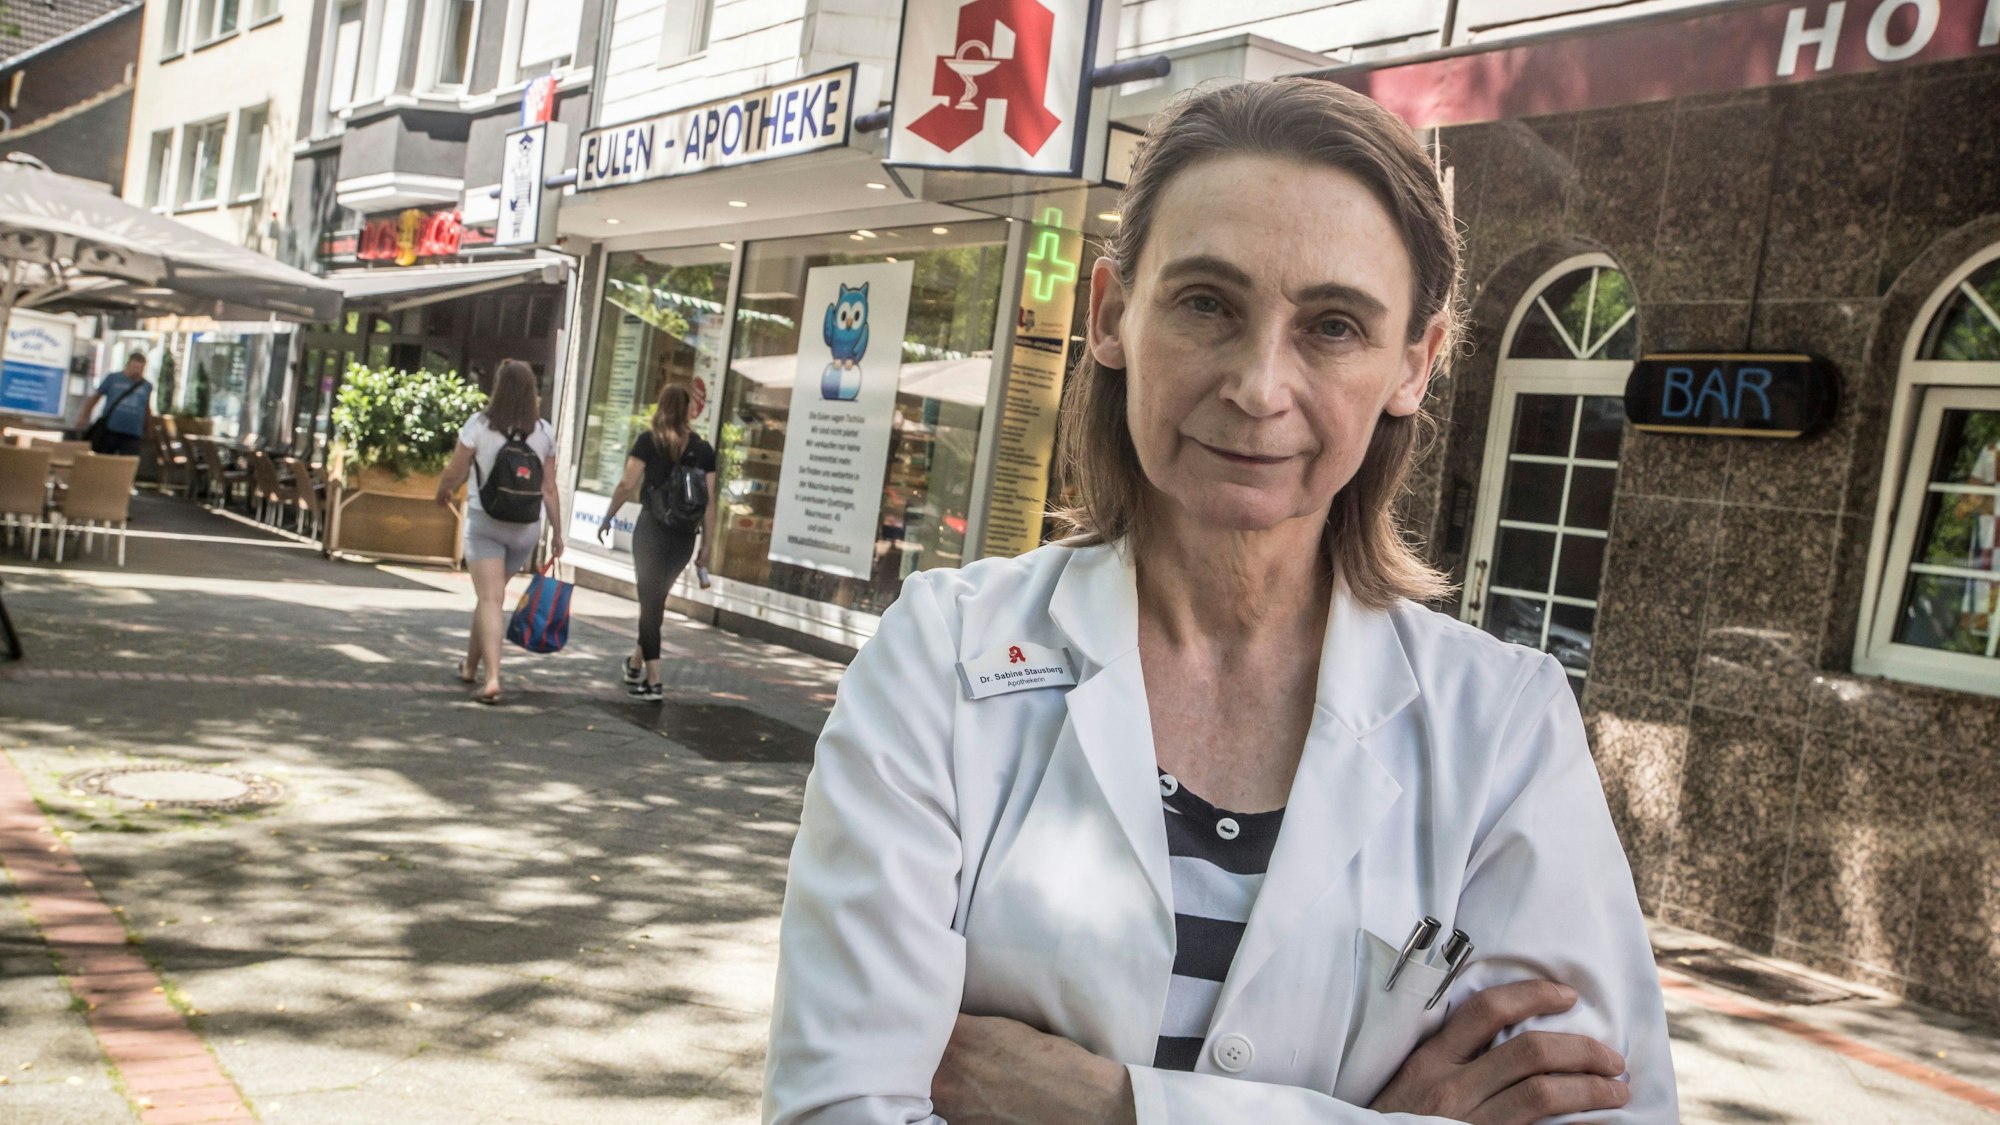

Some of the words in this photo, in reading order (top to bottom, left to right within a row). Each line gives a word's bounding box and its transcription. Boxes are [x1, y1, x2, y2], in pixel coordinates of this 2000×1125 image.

[584, 123, 655, 182] EULEN
[684, 79, 842, 164] APOTHEKE
[1661, 366, 1773, 420] BAR
[980, 676, 994, 685] Dr.
[994, 670, 1023, 681] Sabine
[1024, 666, 1064, 676] Stausberg
[1007, 677, 1046, 688] Apothekerin
